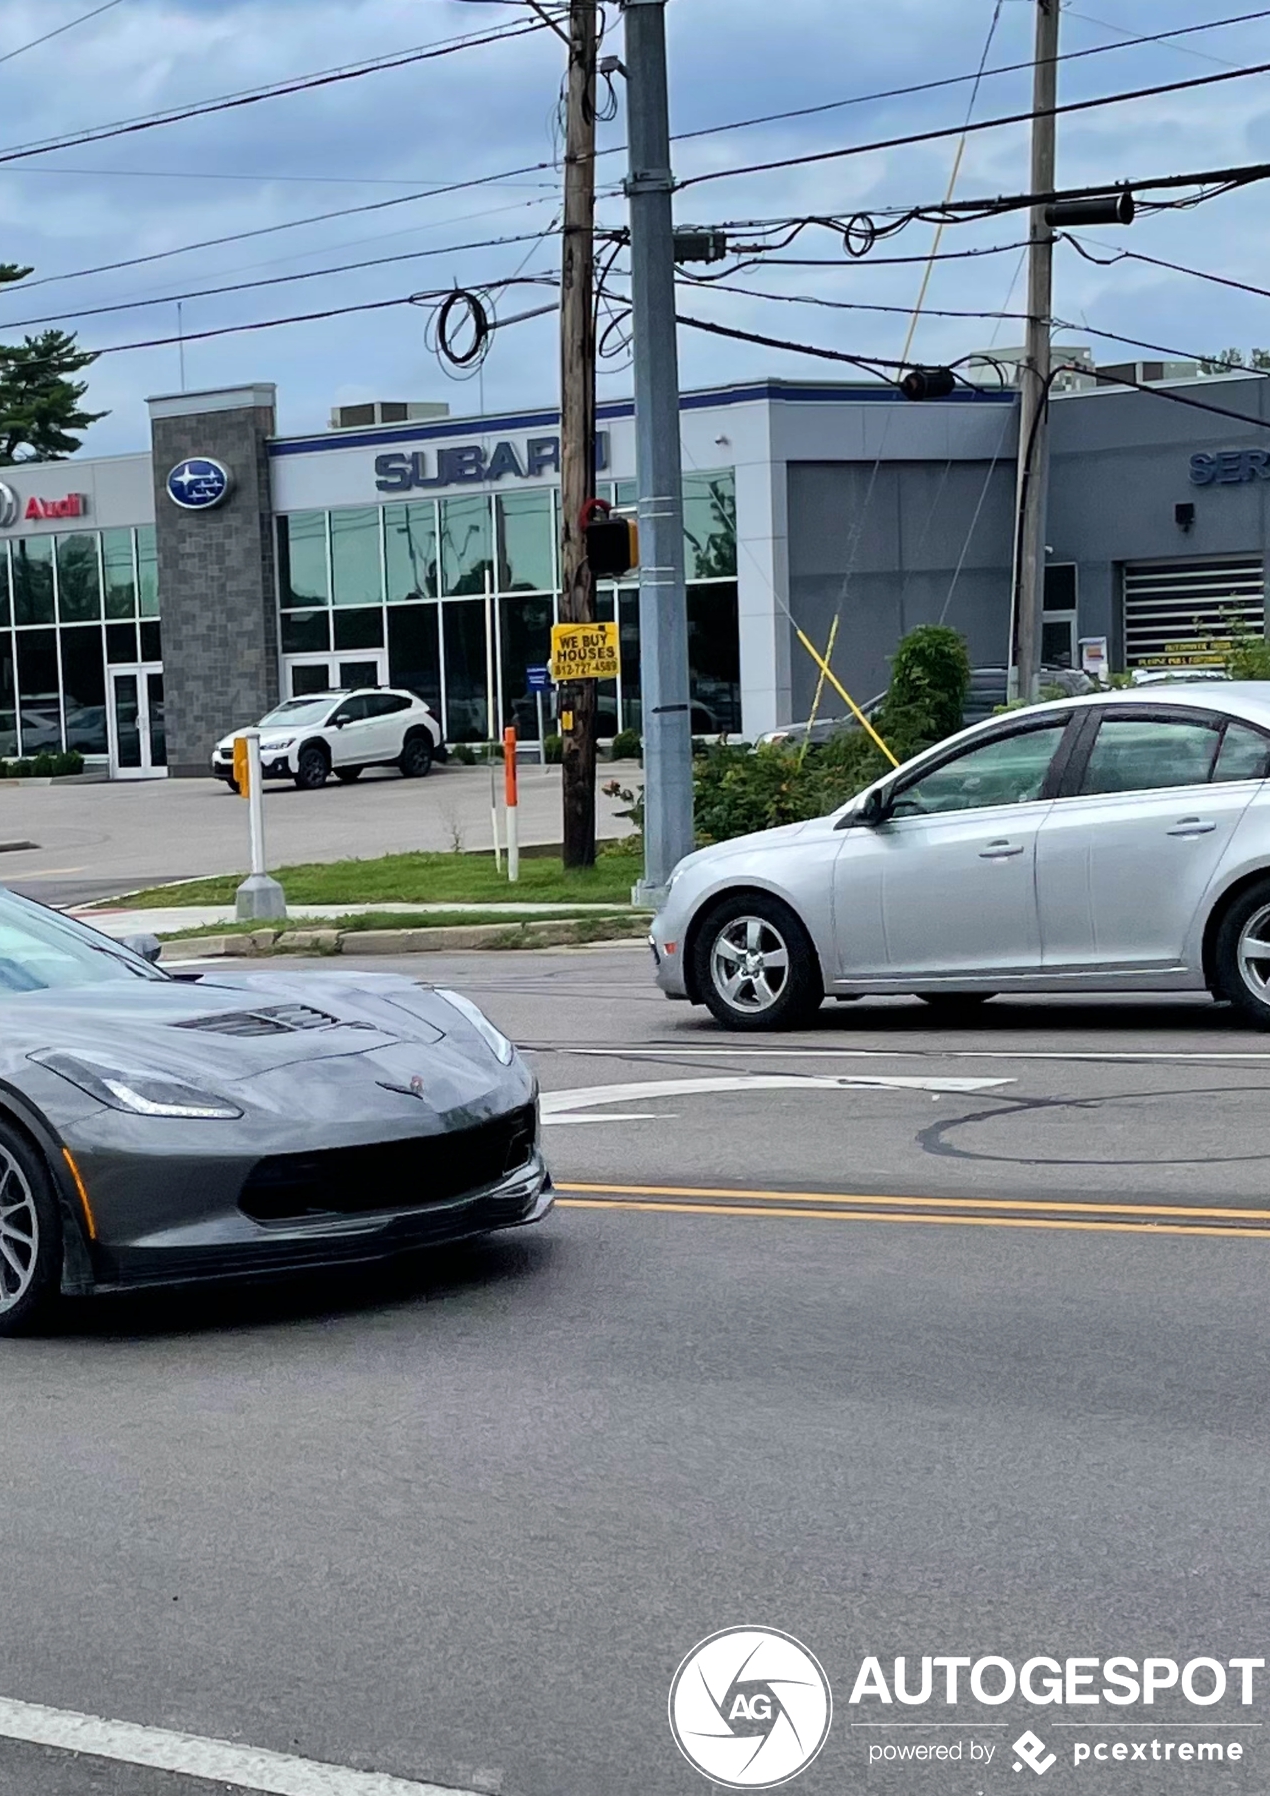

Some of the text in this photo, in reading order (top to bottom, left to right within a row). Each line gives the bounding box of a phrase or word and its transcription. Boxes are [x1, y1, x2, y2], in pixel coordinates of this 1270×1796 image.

[25, 493, 87, 520] Audi
[560, 633, 608, 650] WE BUY
[557, 646, 615, 662] HOUSES
